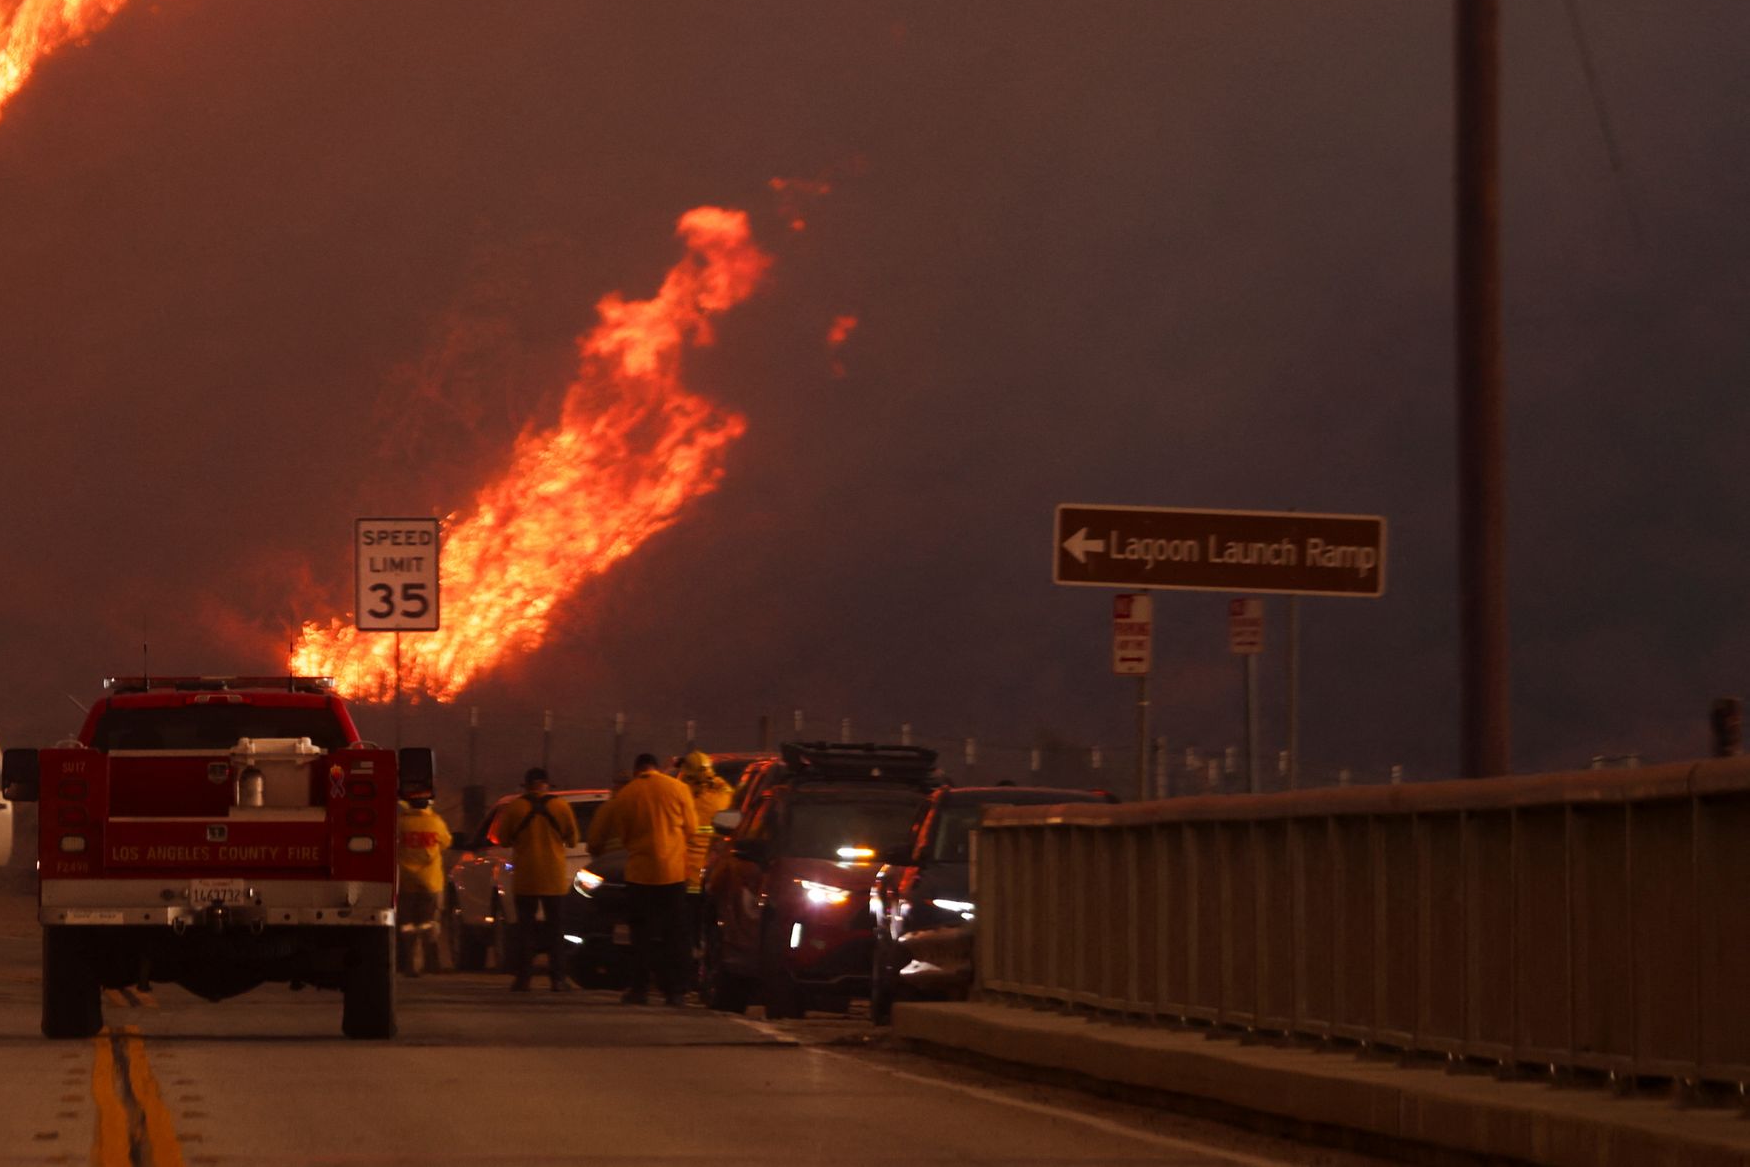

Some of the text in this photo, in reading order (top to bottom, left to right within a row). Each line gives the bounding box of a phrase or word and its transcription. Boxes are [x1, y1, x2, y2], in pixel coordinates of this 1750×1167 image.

[362, 530, 432, 546] SPEED
[1109, 530, 1377, 578] Lagoon Launch Ramp
[369, 556, 424, 573] LIMIT
[367, 582, 429, 619] 35
[111, 845, 321, 861] LOS ANGELES COUNTY FIRE
